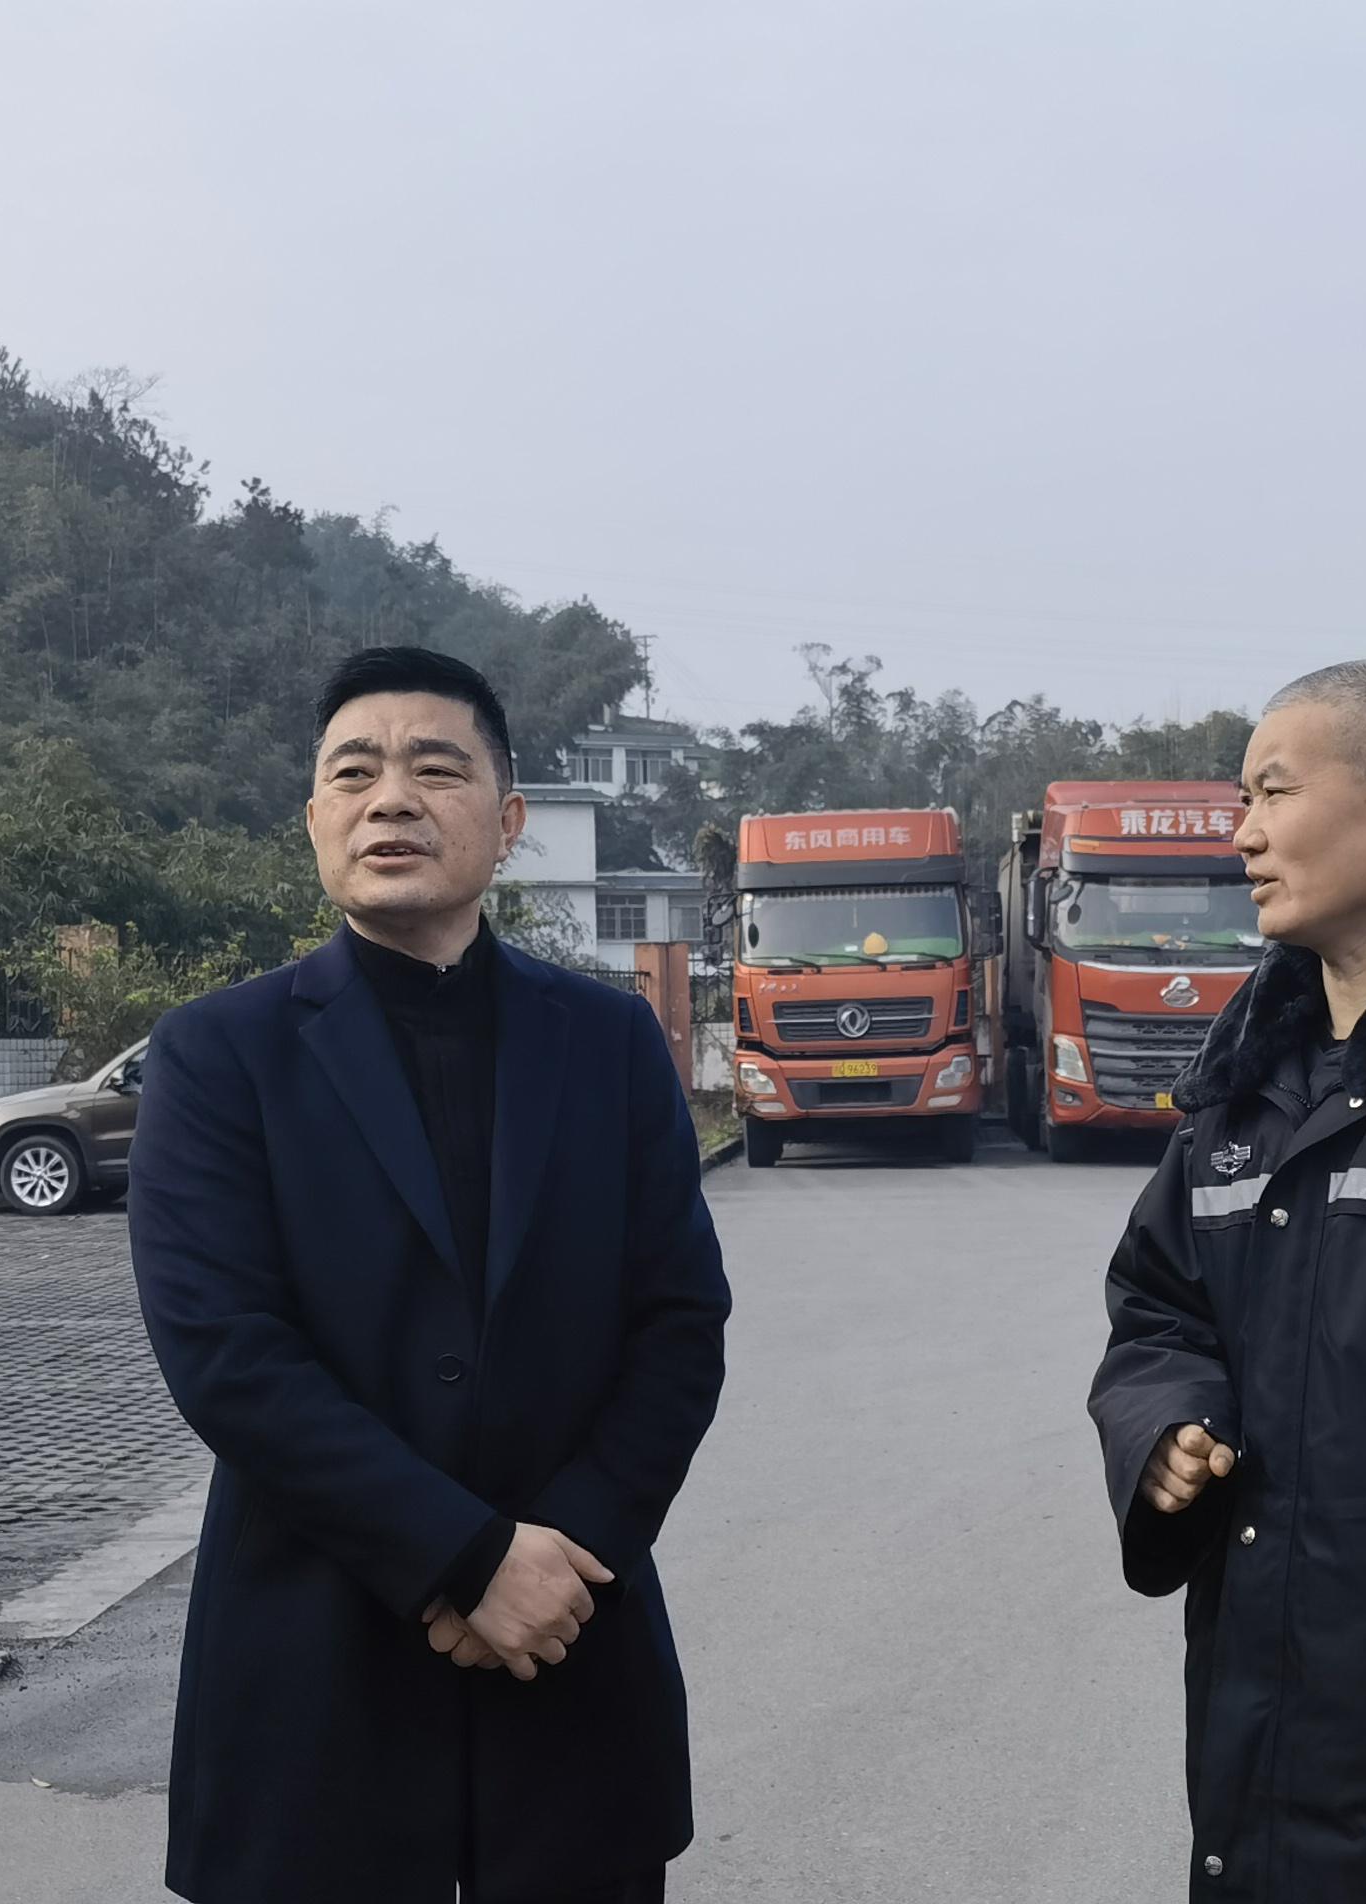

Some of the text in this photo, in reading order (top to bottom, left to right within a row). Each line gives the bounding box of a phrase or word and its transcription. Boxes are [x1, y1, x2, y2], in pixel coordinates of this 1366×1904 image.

[1120, 809, 1234, 835] 乘龙汽车
[786, 826, 911, 850] 东风商用车
